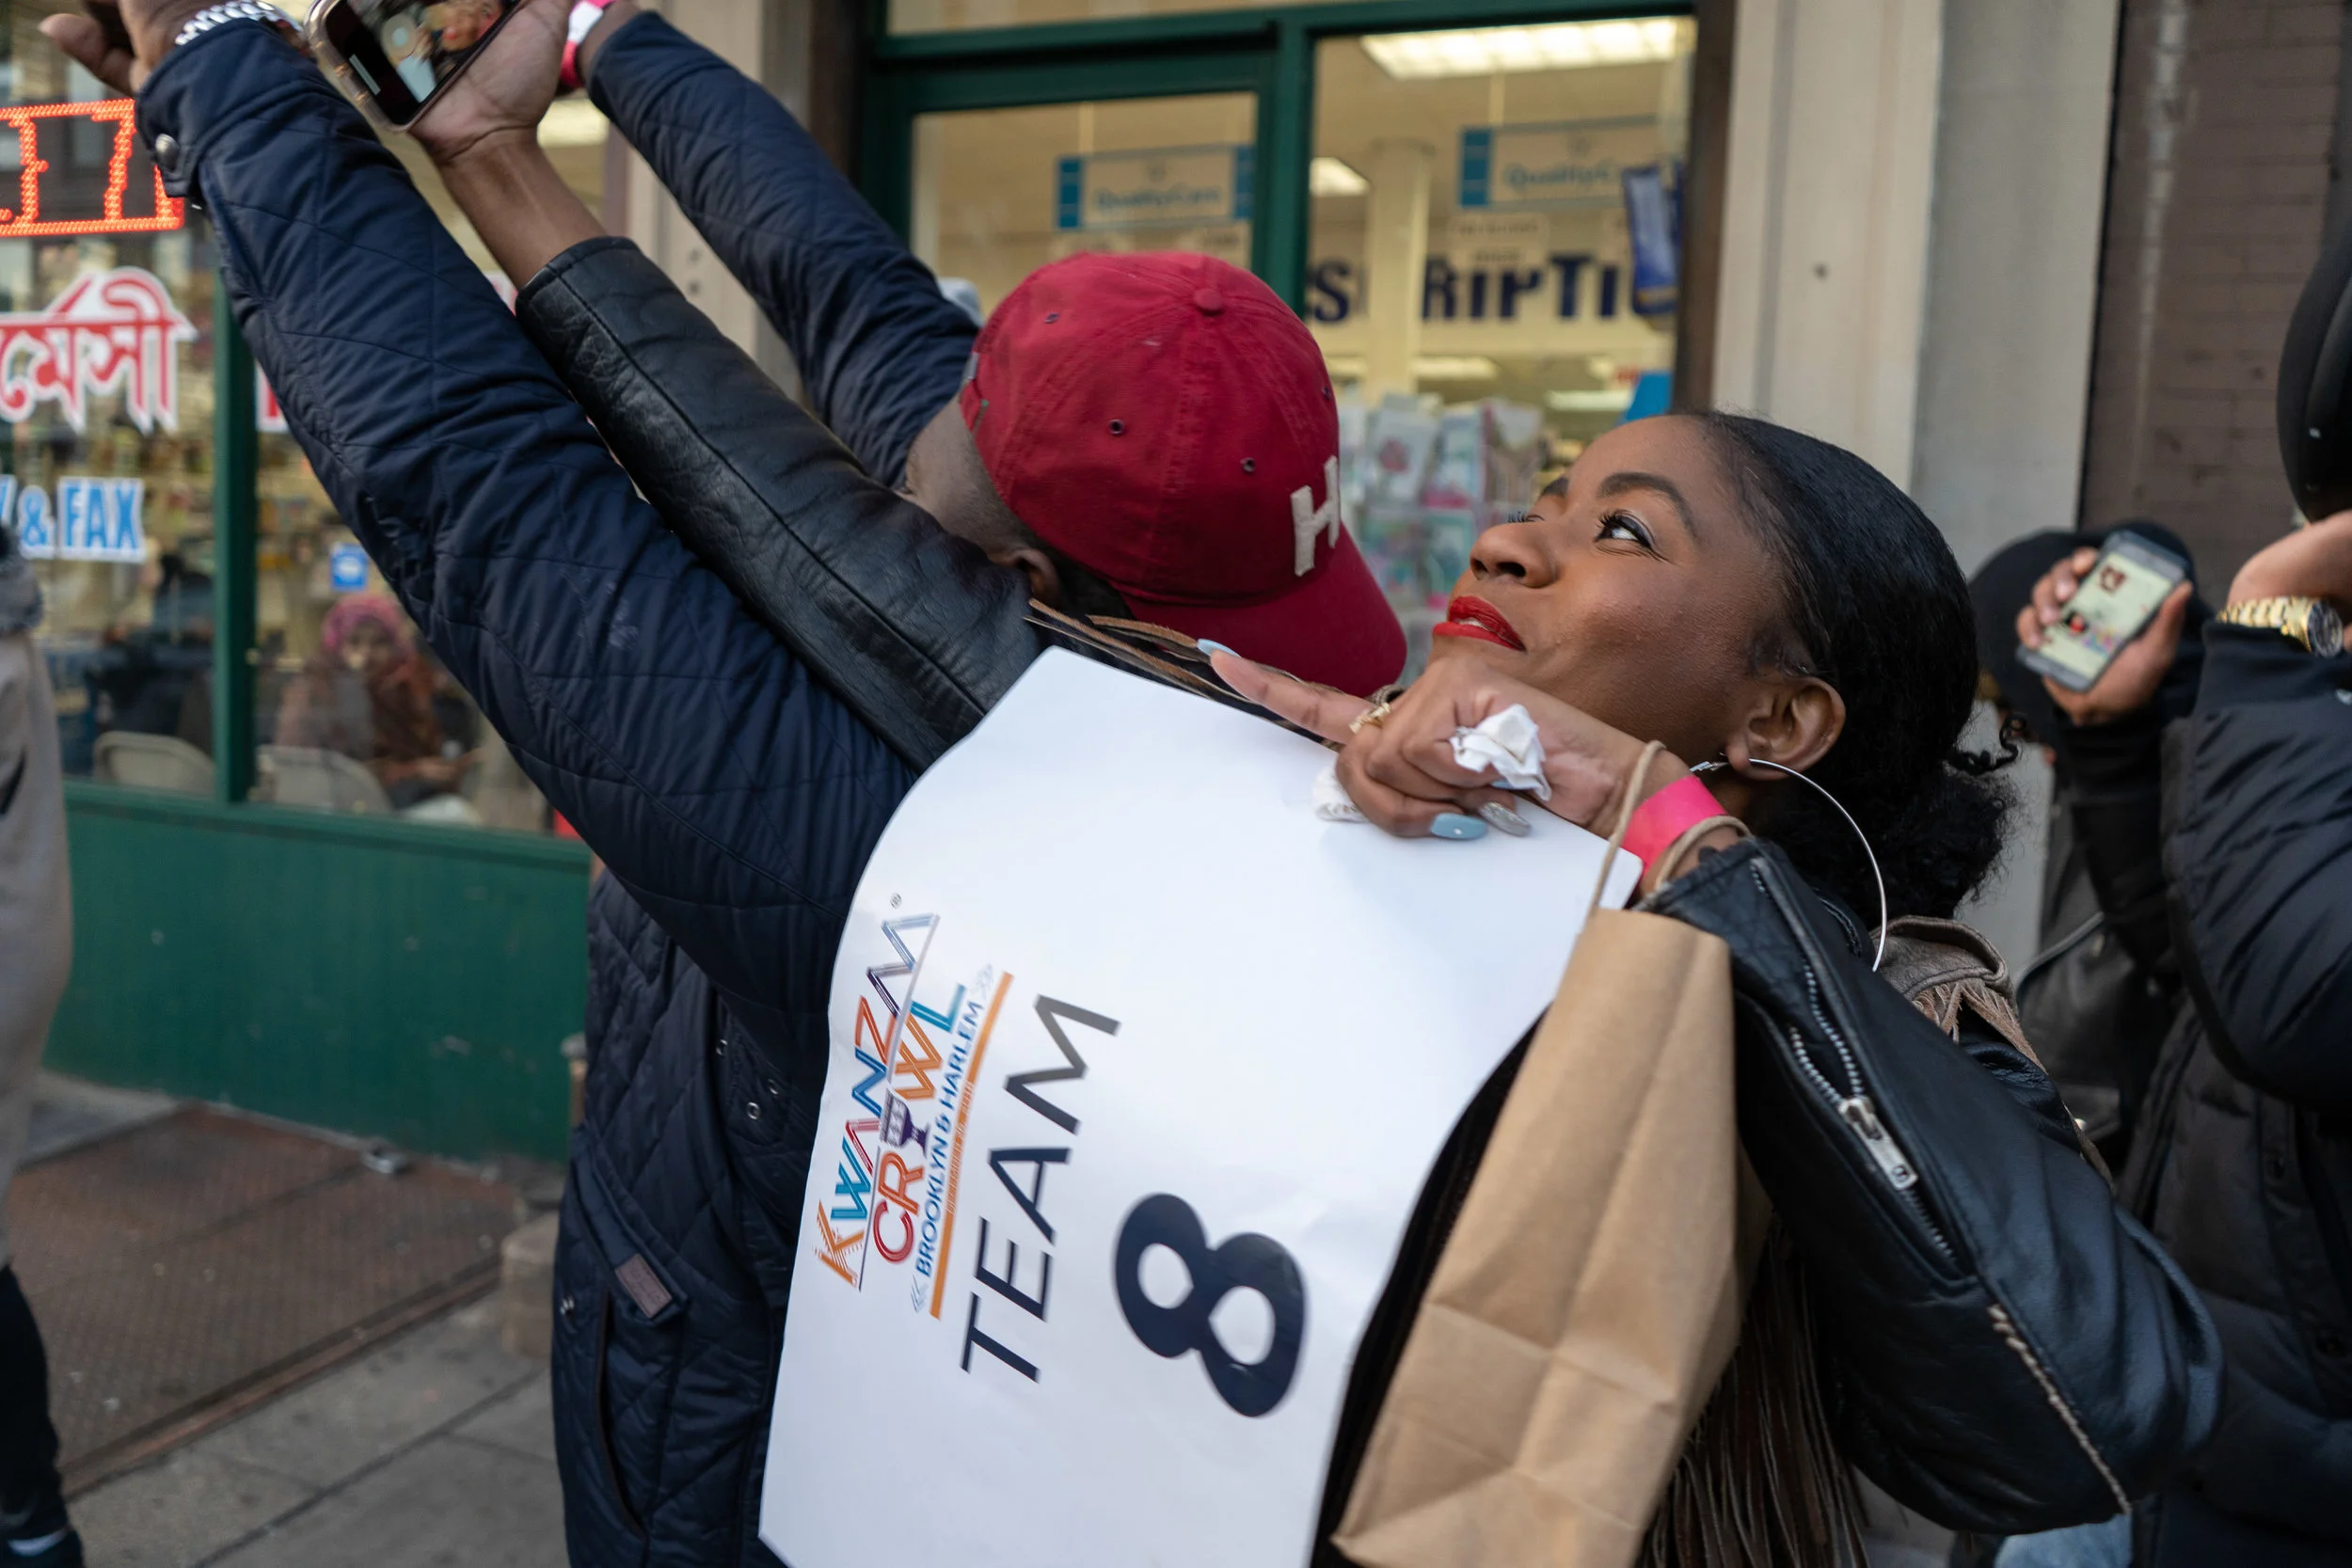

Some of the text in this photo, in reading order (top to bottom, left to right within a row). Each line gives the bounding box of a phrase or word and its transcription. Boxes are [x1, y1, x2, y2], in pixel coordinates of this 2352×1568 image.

[23, 499, 51, 544] &
[63, 485, 137, 551] FAX
[1290, 454, 1341, 577] H
[915, 1001, 985, 1278] BROOKLYN & HARLEM
[960, 993, 1121, 1384] TEAM
[1113, 1193, 1309, 1418] 8
